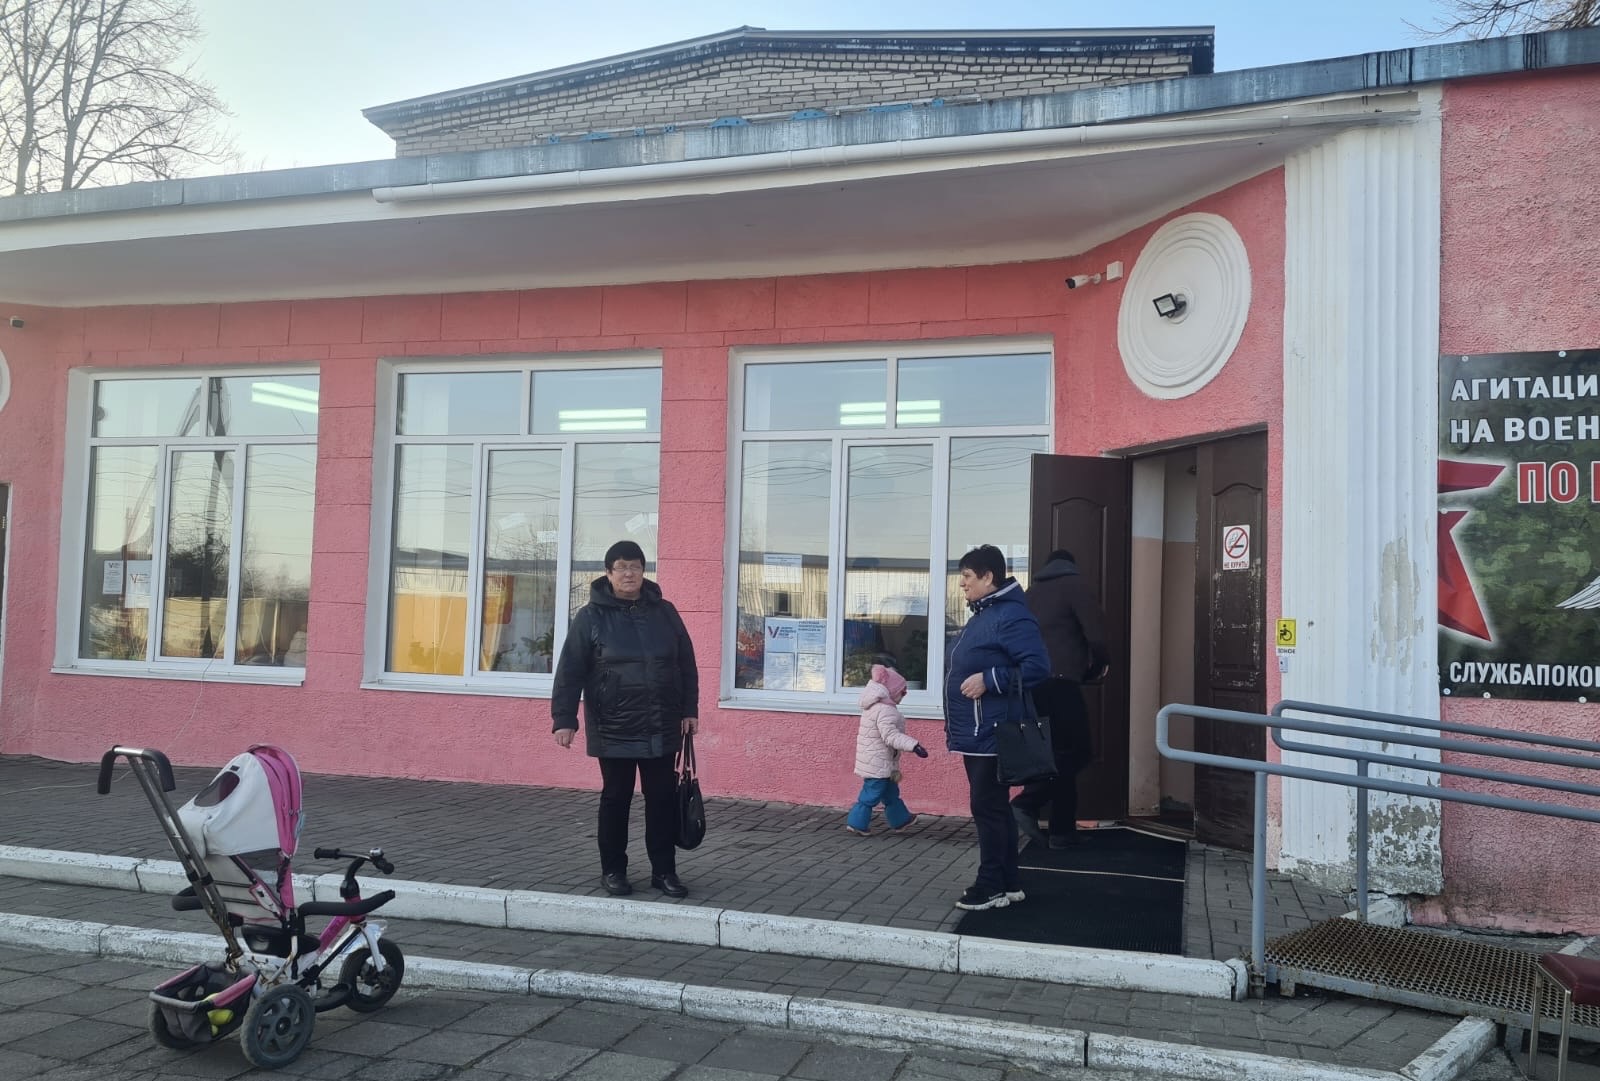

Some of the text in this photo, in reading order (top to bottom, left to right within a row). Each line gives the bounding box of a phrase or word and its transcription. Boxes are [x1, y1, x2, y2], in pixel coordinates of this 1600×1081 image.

[1451, 374, 1599, 401] АГИТАЦИ
[1450, 415, 1600, 444] НА ВОЕН
[1517, 460, 1579, 504] ПО
